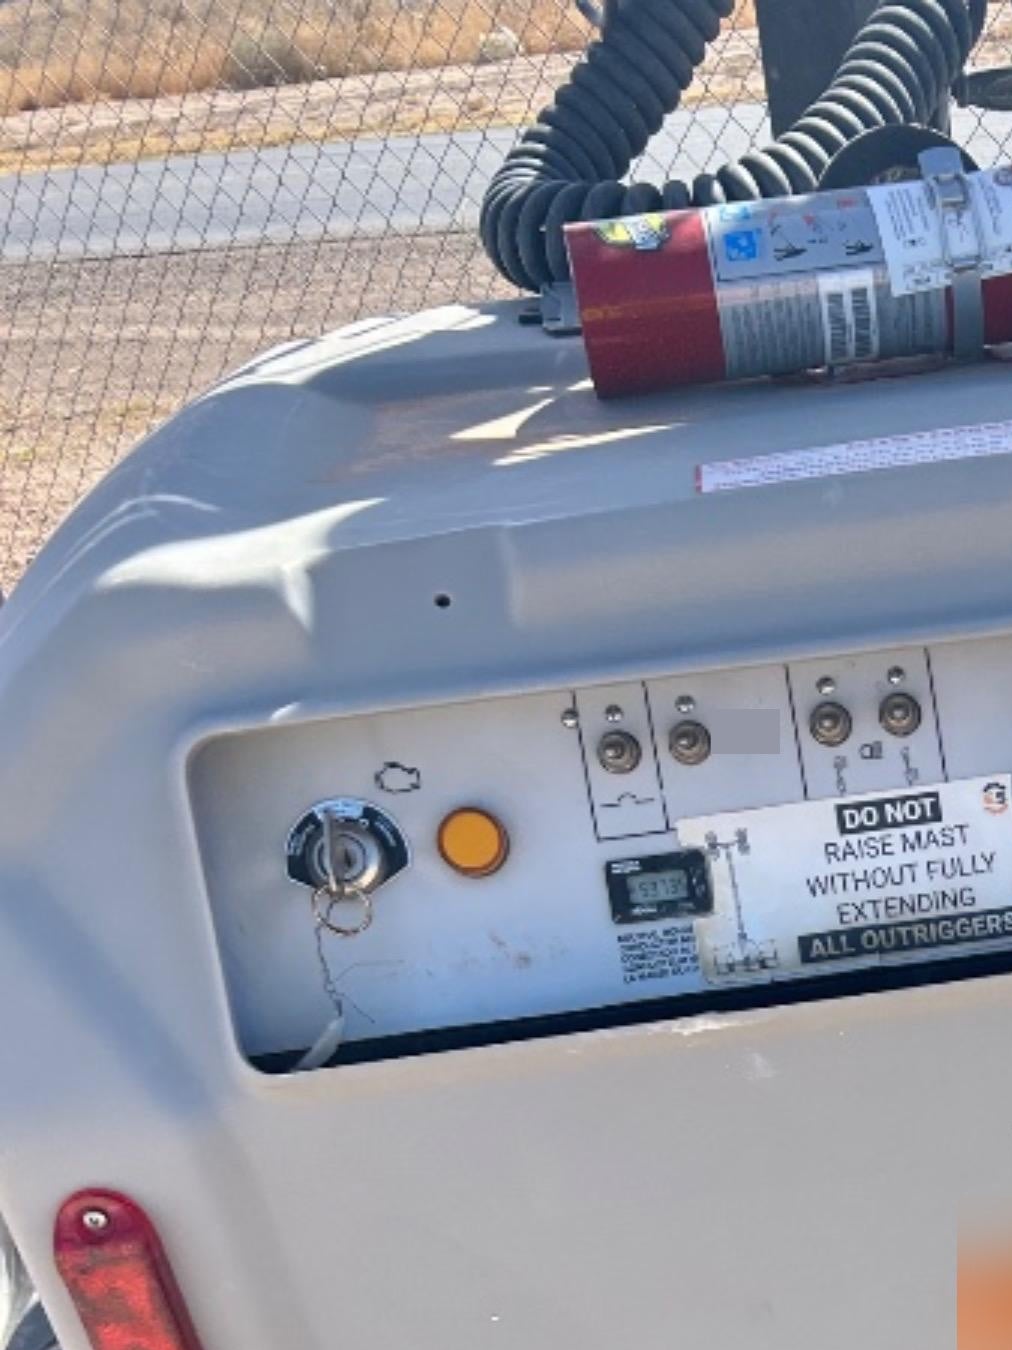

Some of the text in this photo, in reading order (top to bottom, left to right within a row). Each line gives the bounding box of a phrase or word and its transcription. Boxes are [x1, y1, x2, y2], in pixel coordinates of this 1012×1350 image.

[842, 798, 936, 829] DO NOT
[824, 824, 969, 864] RAISE MAST
[806, 851, 996, 898] WITHOUT FULLY
[836, 887, 976, 925] EXTENDING
[809, 934, 855, 959] ALL
